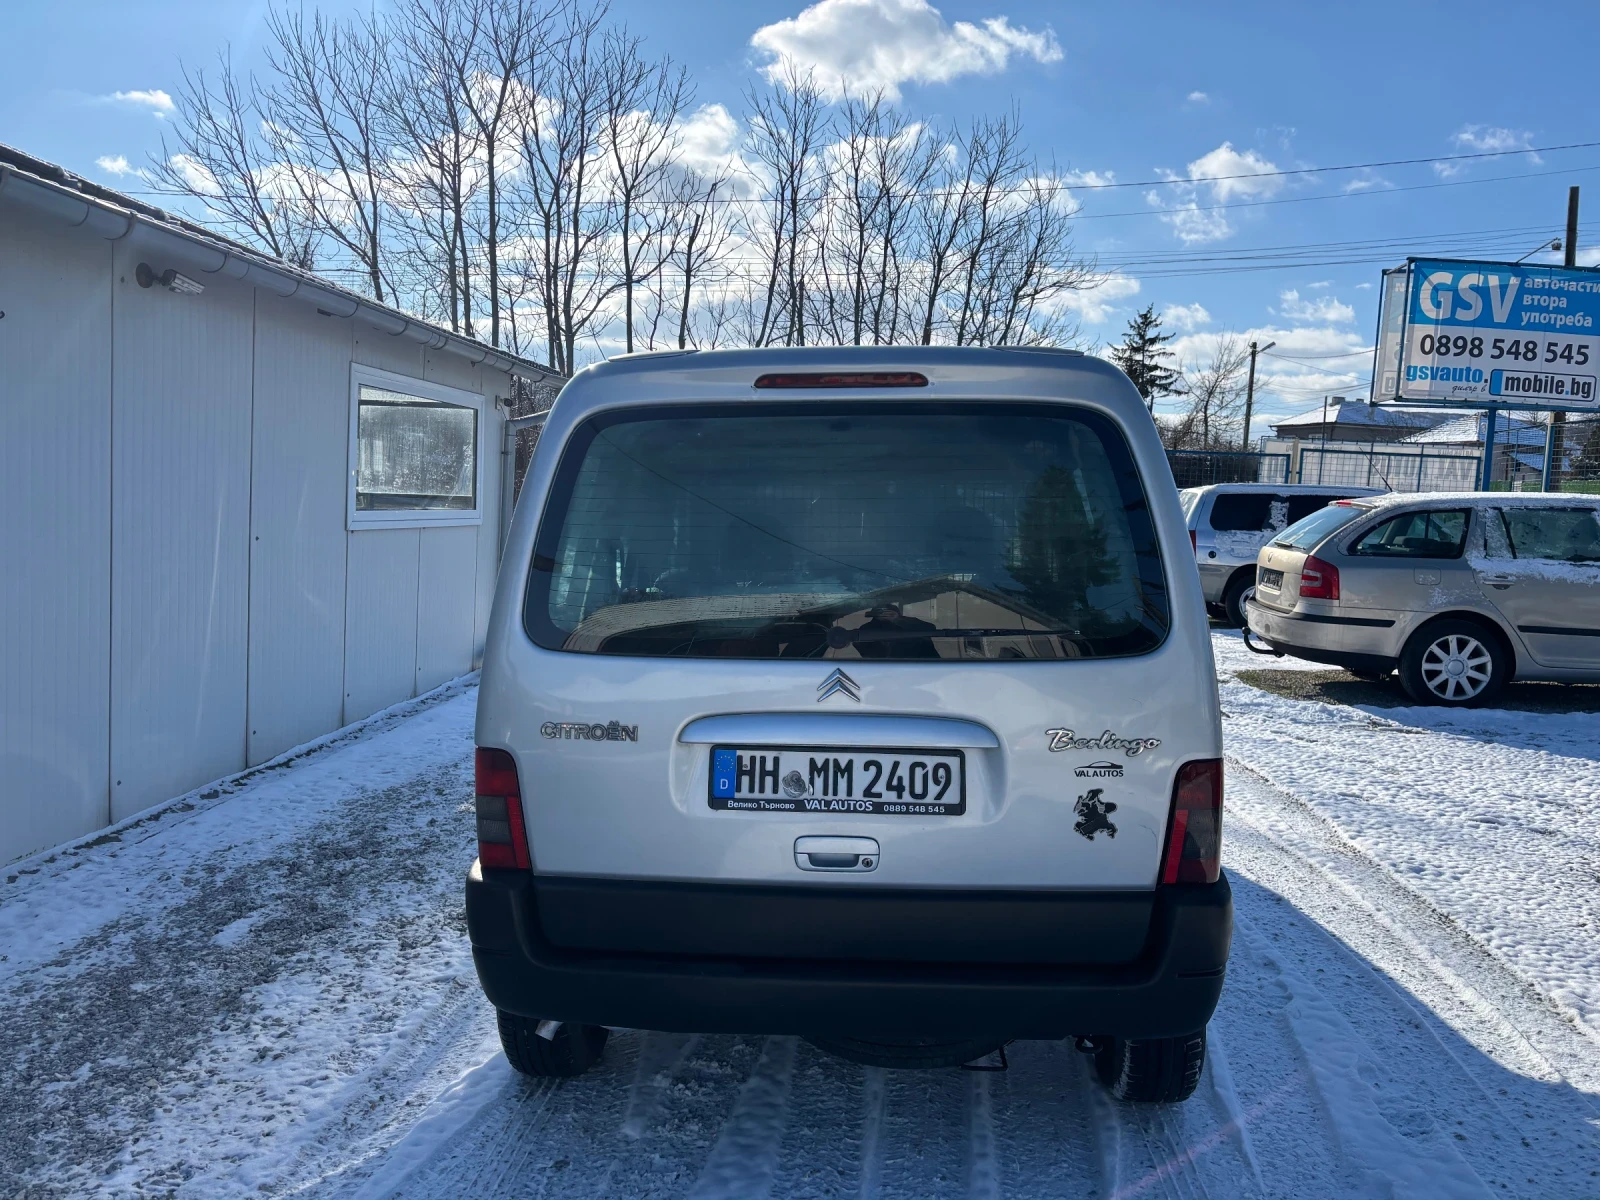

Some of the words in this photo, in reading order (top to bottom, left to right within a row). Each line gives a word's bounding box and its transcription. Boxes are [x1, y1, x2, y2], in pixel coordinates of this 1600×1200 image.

[1524, 277, 1600, 293] авточасти
[1420, 271, 1522, 324] GSV
[1522, 294, 1568, 311] втора
[1521, 311, 1593, 329] употреба
[1420, 333, 1484, 358] 0898
[1490, 338, 1538, 361] 548
[1544, 342, 1590, 365] 545
[1504, 374, 1593, 398] mobile.bg
[540, 720, 639, 742] CITROËN
[1045, 727, 1162, 757] Berlingo
[720, 778, 729, 789] D
[735, 754, 780, 795] HH
[808, 757, 853, 797] MM
[863, 759, 952, 800] 2409
[727, 800, 758, 809] Велико
[759, 801, 796, 810] Търново
[883, 804, 907, 812] 0889
[908, 805, 926, 813] 548
[928, 805, 945, 813] 545
